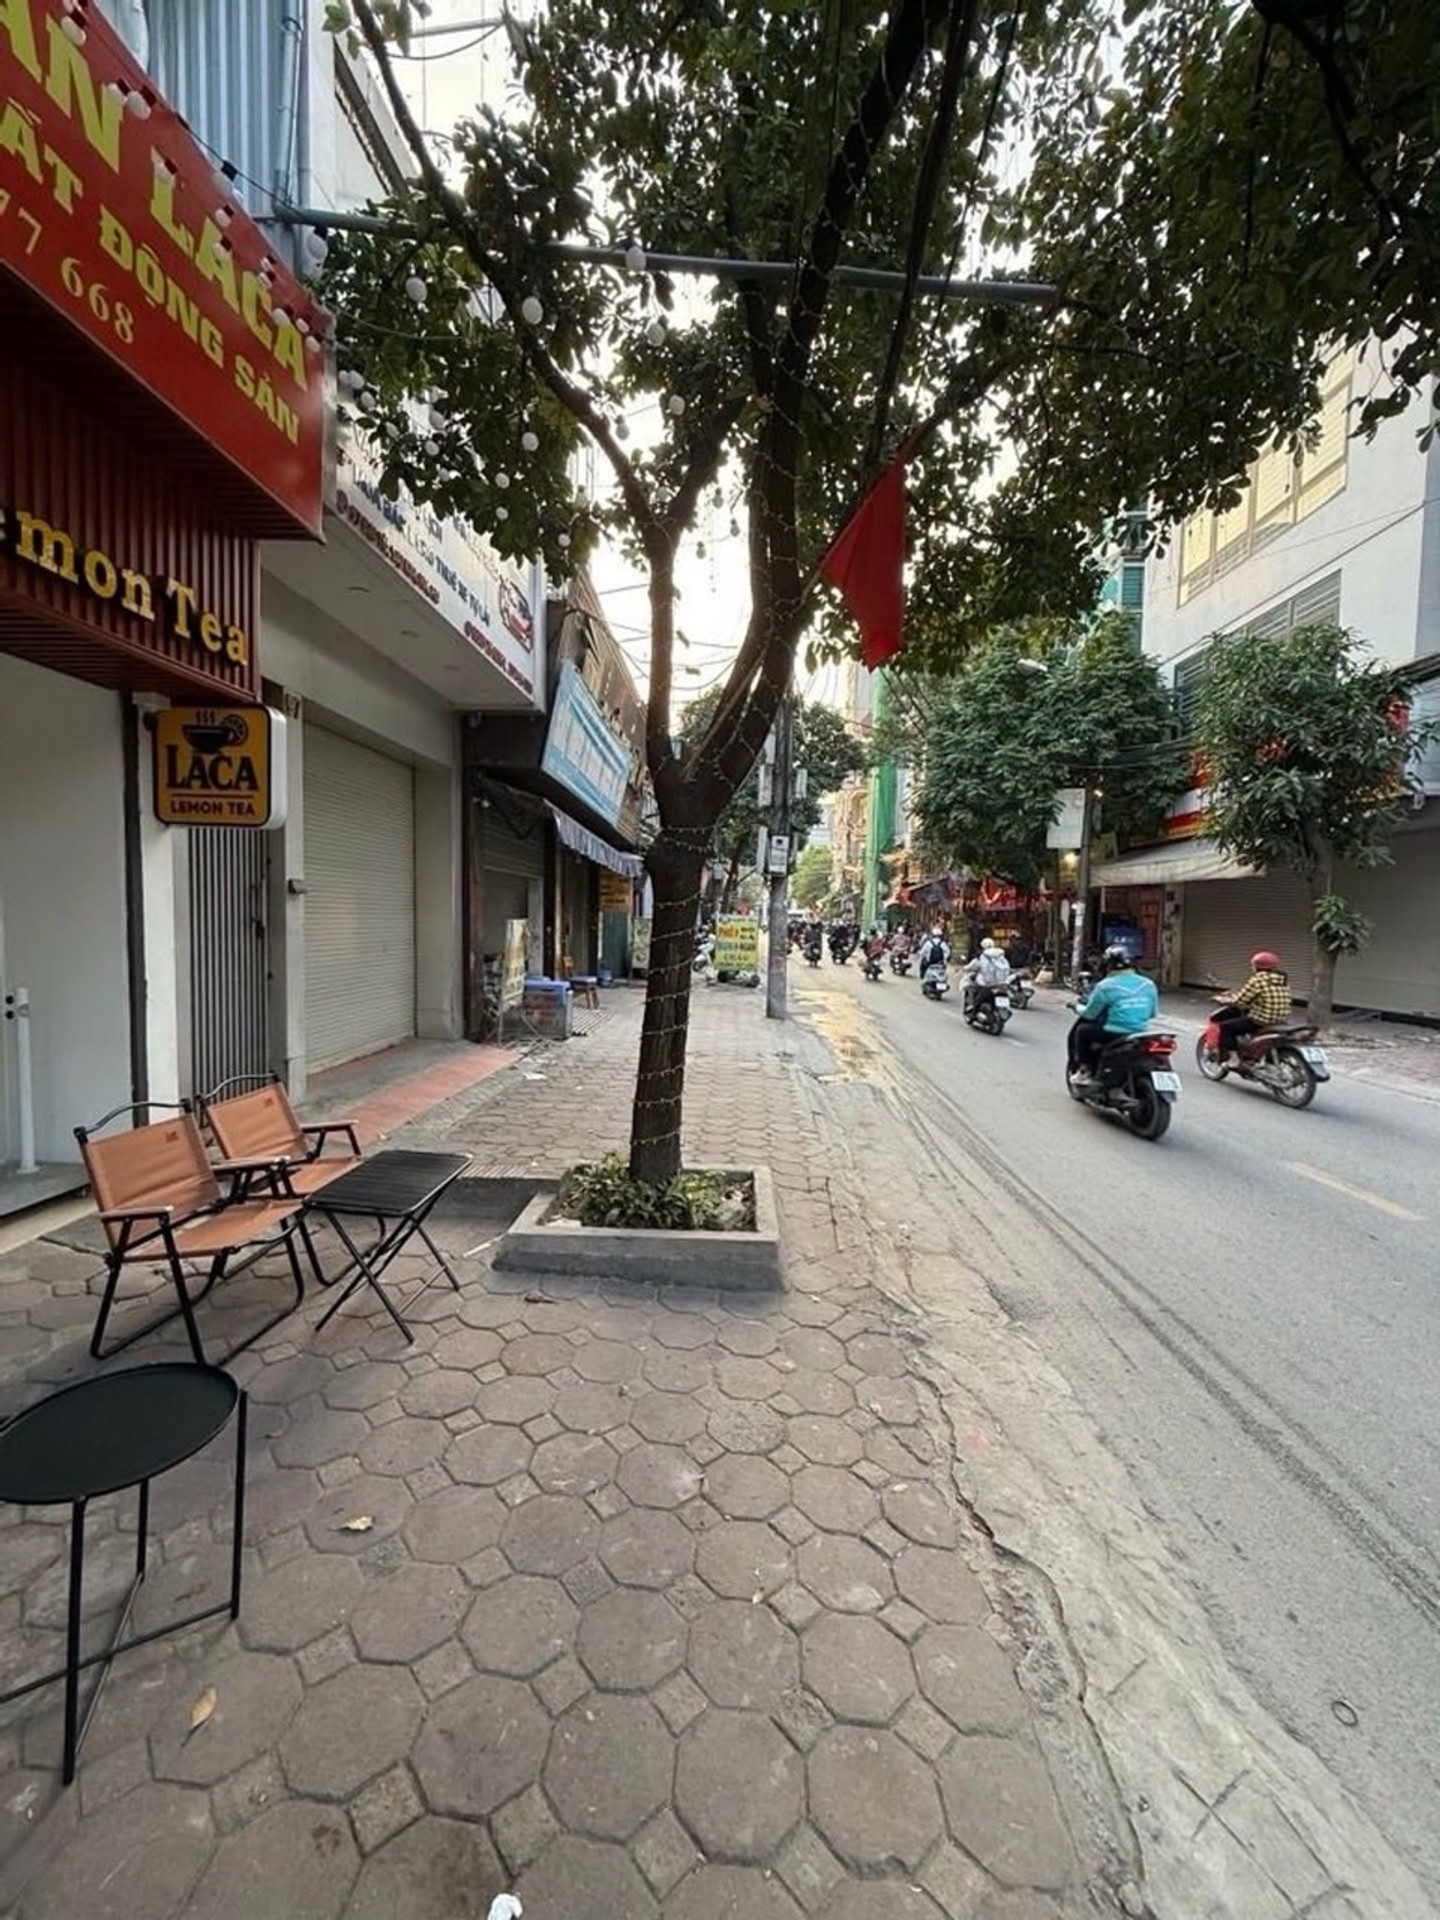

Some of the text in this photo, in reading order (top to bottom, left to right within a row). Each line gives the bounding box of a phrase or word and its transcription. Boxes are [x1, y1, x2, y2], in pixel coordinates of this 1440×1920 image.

[60, 256, 134, 345] 668
[99, 203, 224, 369] ĐỘNG
[234, 354, 299, 446] SẢN
[150, 146, 307, 392] LACA
[0, 508, 248, 666] mon Tea
[166, 744, 260, 791] LACA
[170, 801, 256, 816] LEMON TEA
